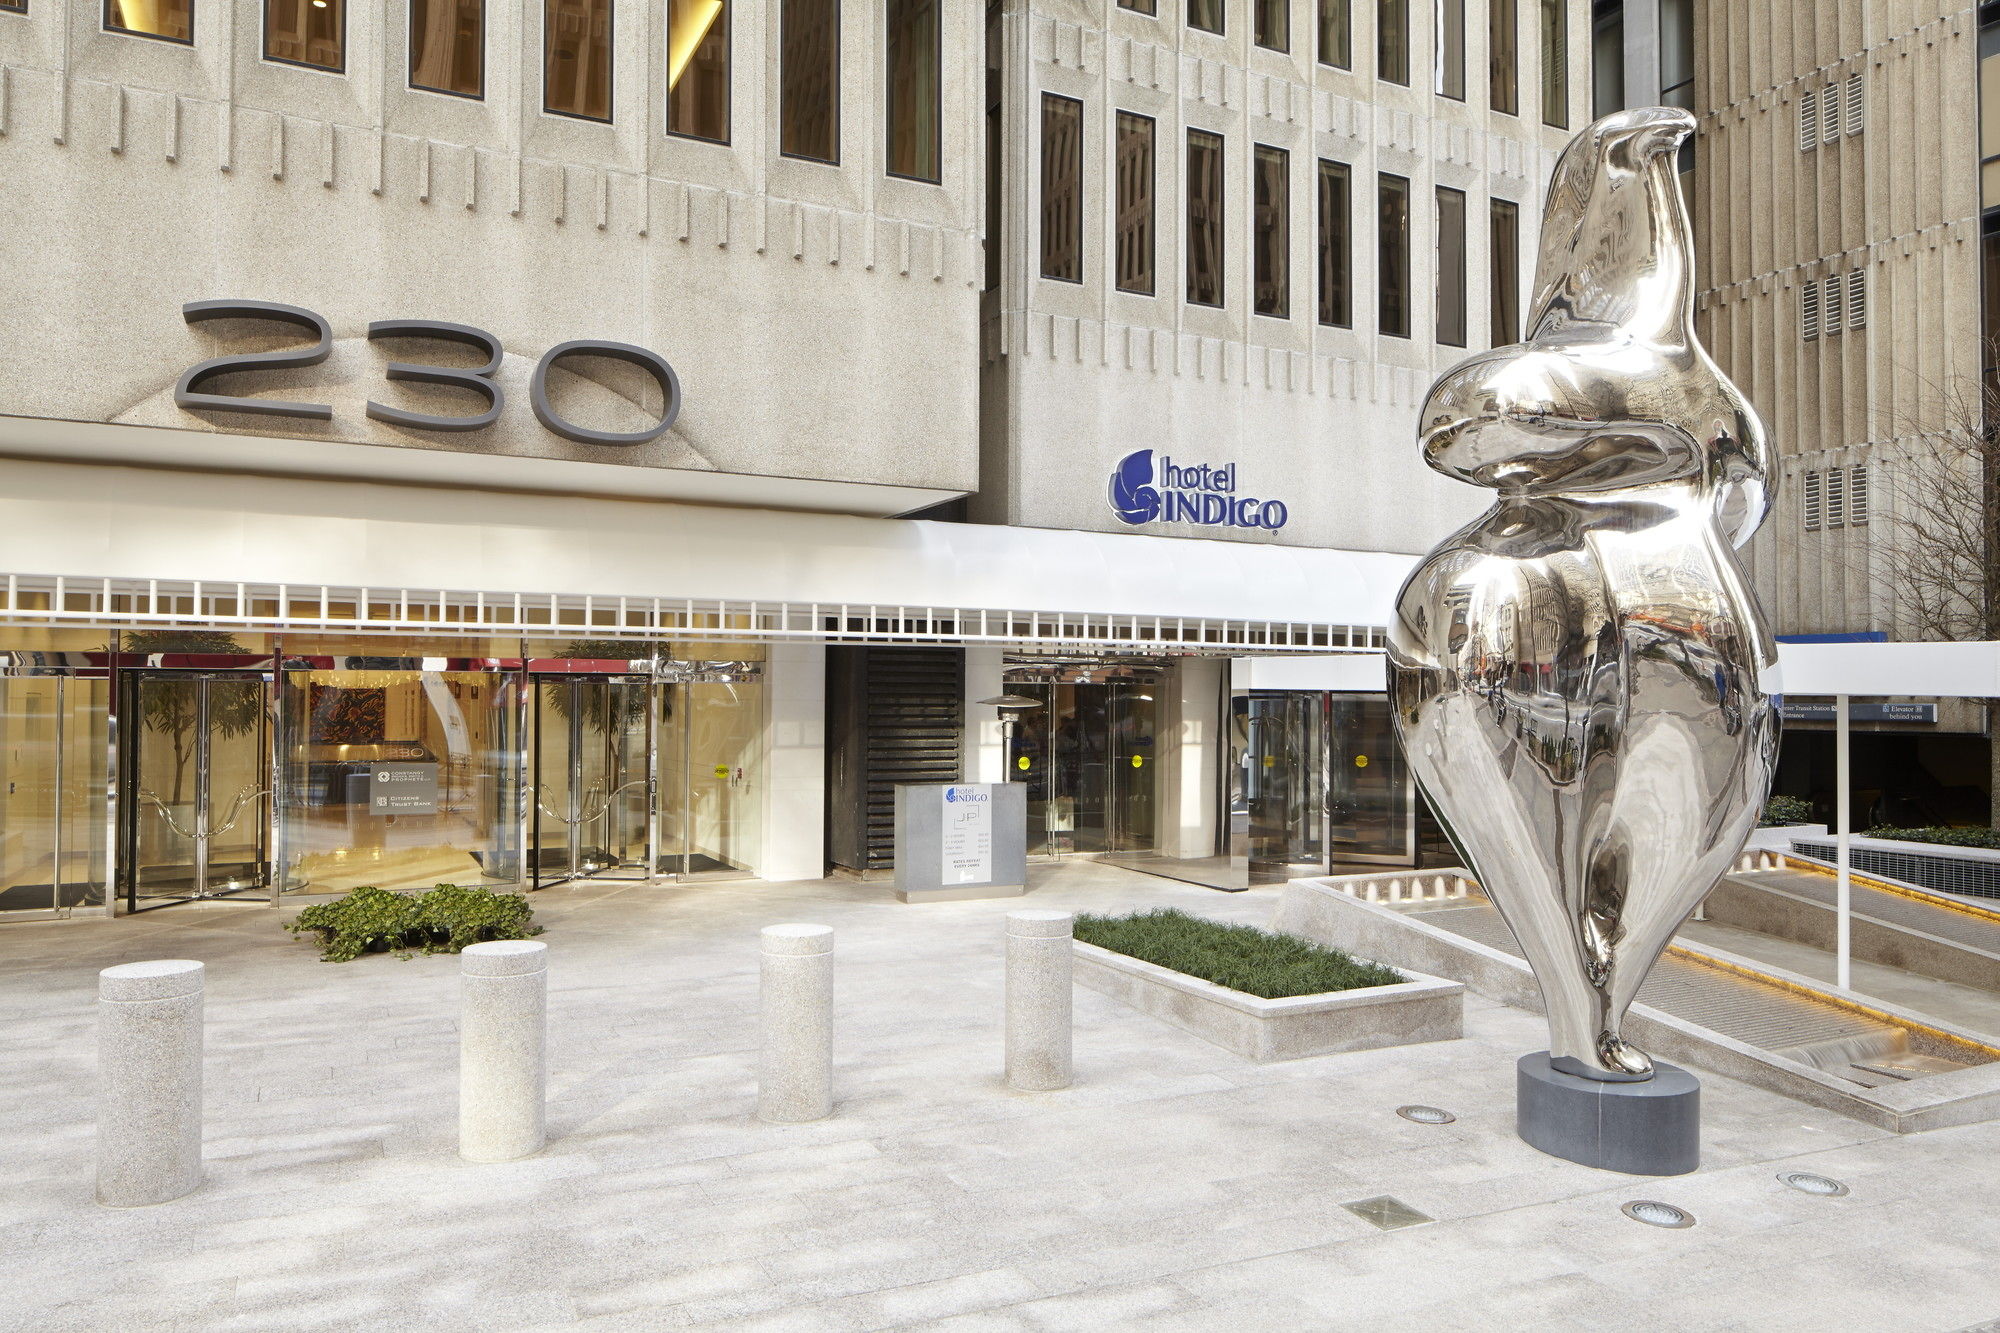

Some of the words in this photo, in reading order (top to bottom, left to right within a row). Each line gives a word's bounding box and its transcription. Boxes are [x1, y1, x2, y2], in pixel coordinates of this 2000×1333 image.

[174, 299, 682, 446] 230
[1160, 456, 1235, 492] hotel
[1160, 491, 1288, 529] INDIGO
[955, 794, 988, 803] INDIGO
